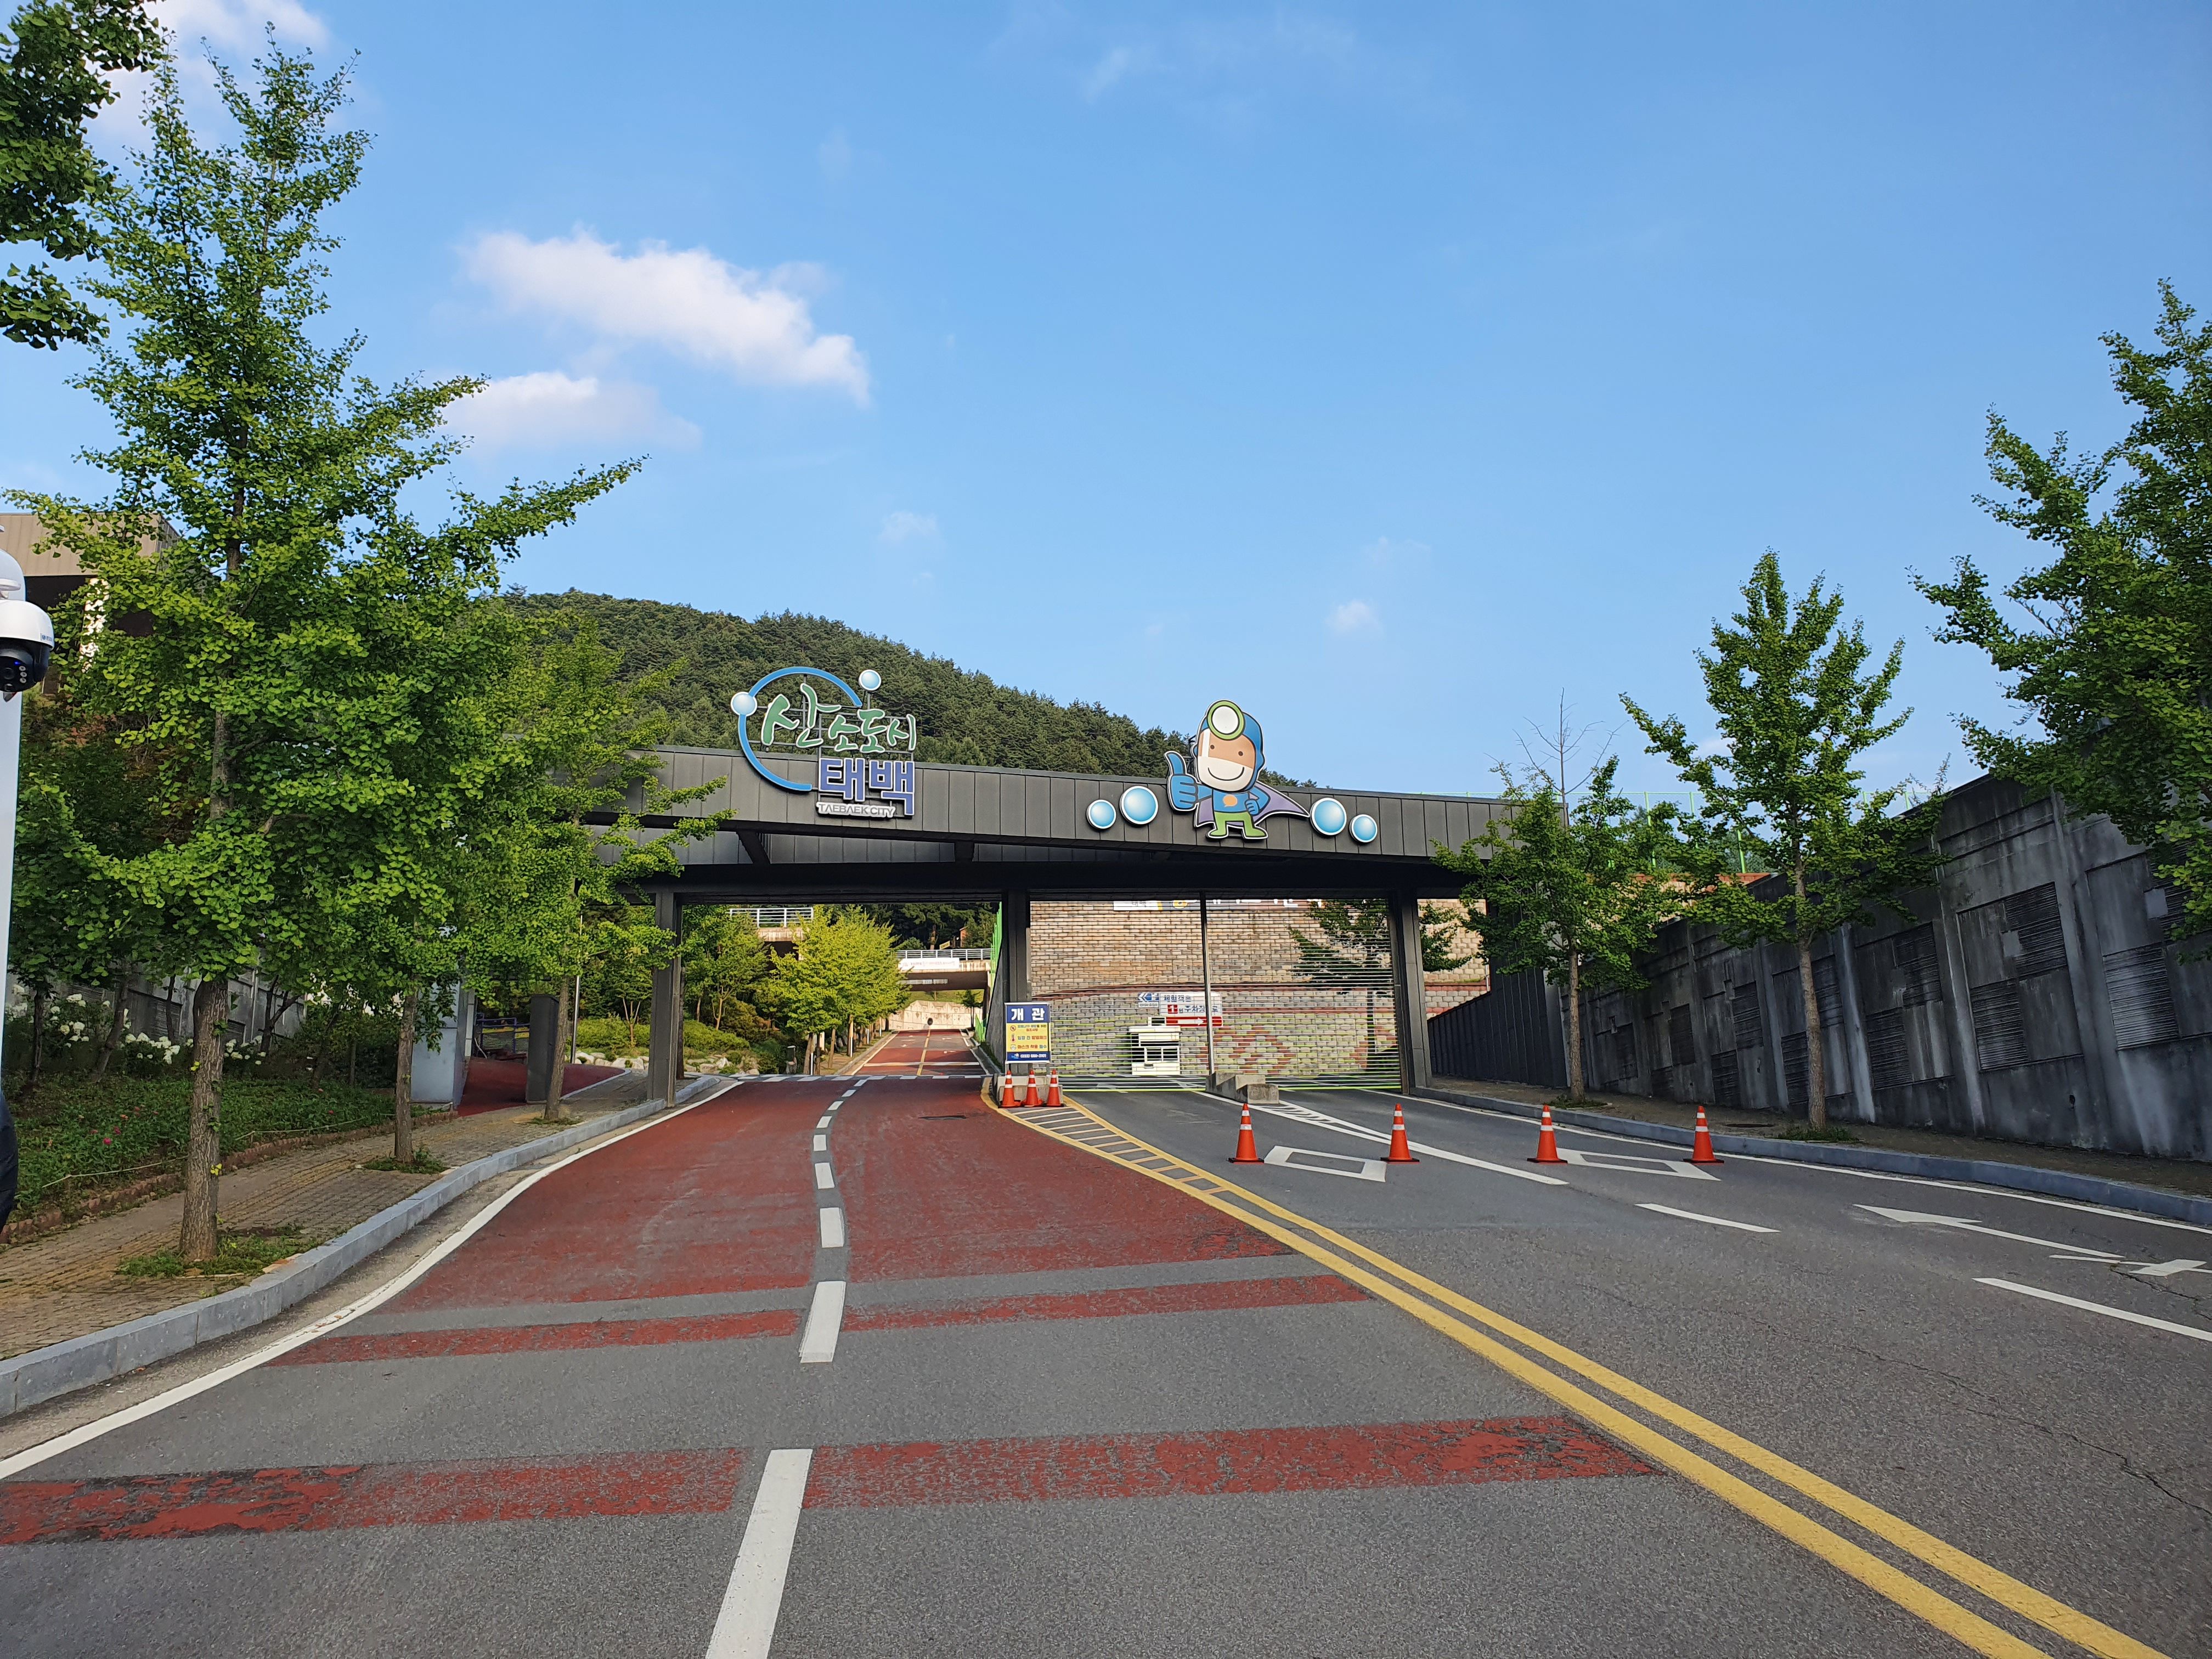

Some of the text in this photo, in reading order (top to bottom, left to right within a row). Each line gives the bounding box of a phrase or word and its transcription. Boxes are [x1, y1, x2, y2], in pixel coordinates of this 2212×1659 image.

[761, 683, 916, 753] 산소도시
[819, 758, 915, 815] 태백
[819, 803, 894, 816] TAEBAEK CITY
